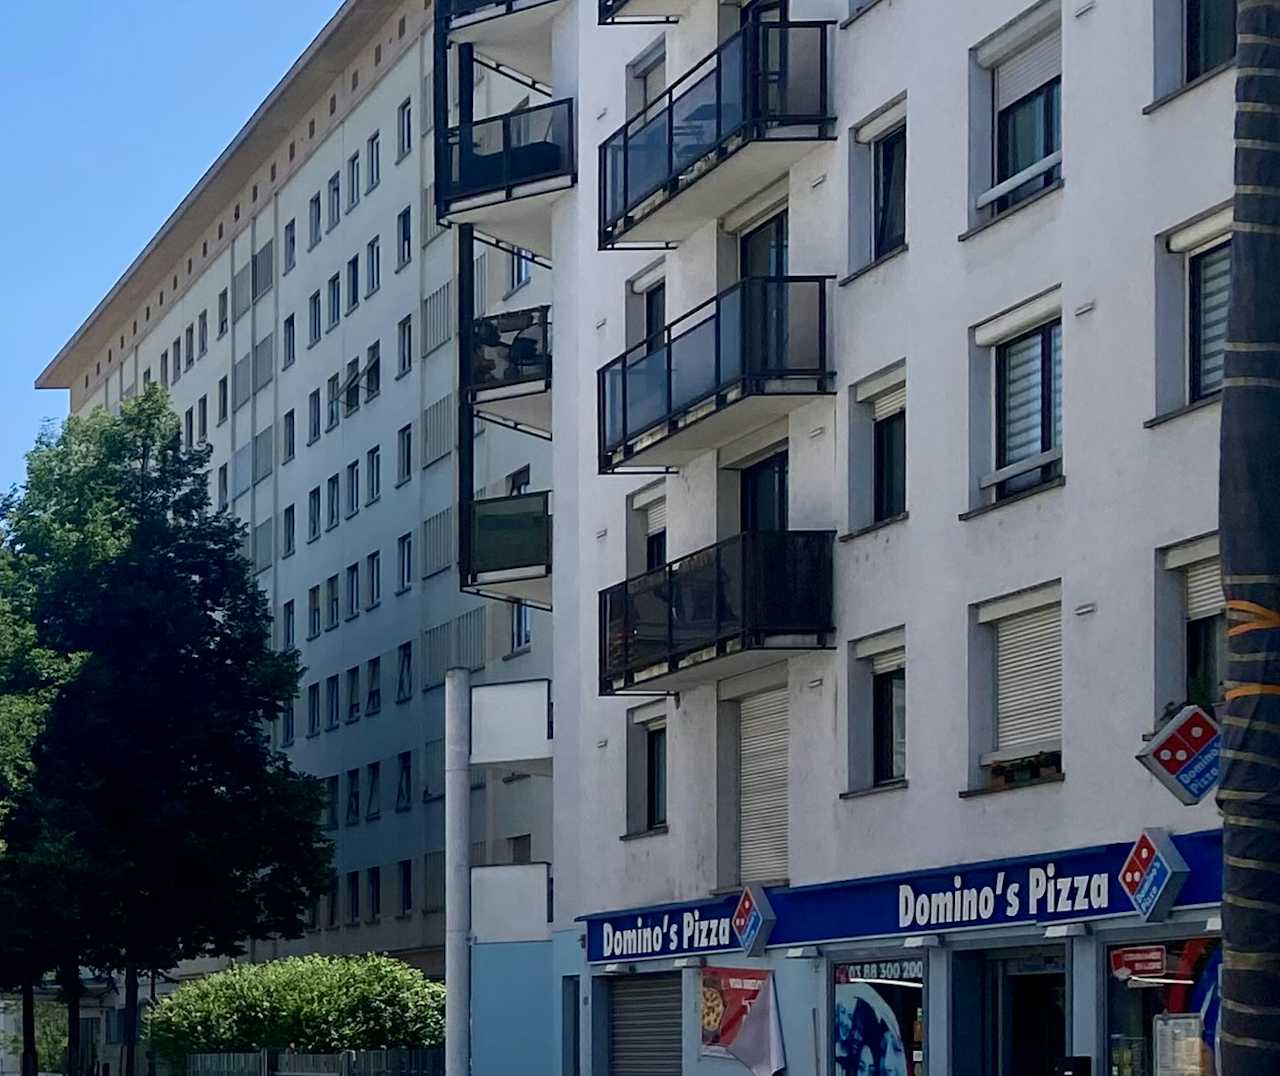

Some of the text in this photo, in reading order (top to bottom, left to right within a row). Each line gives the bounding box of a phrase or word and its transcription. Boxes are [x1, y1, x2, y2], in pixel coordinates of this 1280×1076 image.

[899, 862, 1109, 928] Domino's Pizza
[603, 914, 678, 957] Domino's
[683, 909, 730, 949] Pizza
[863, 963, 877, 978] 88
[902, 961, 923, 978] 200
